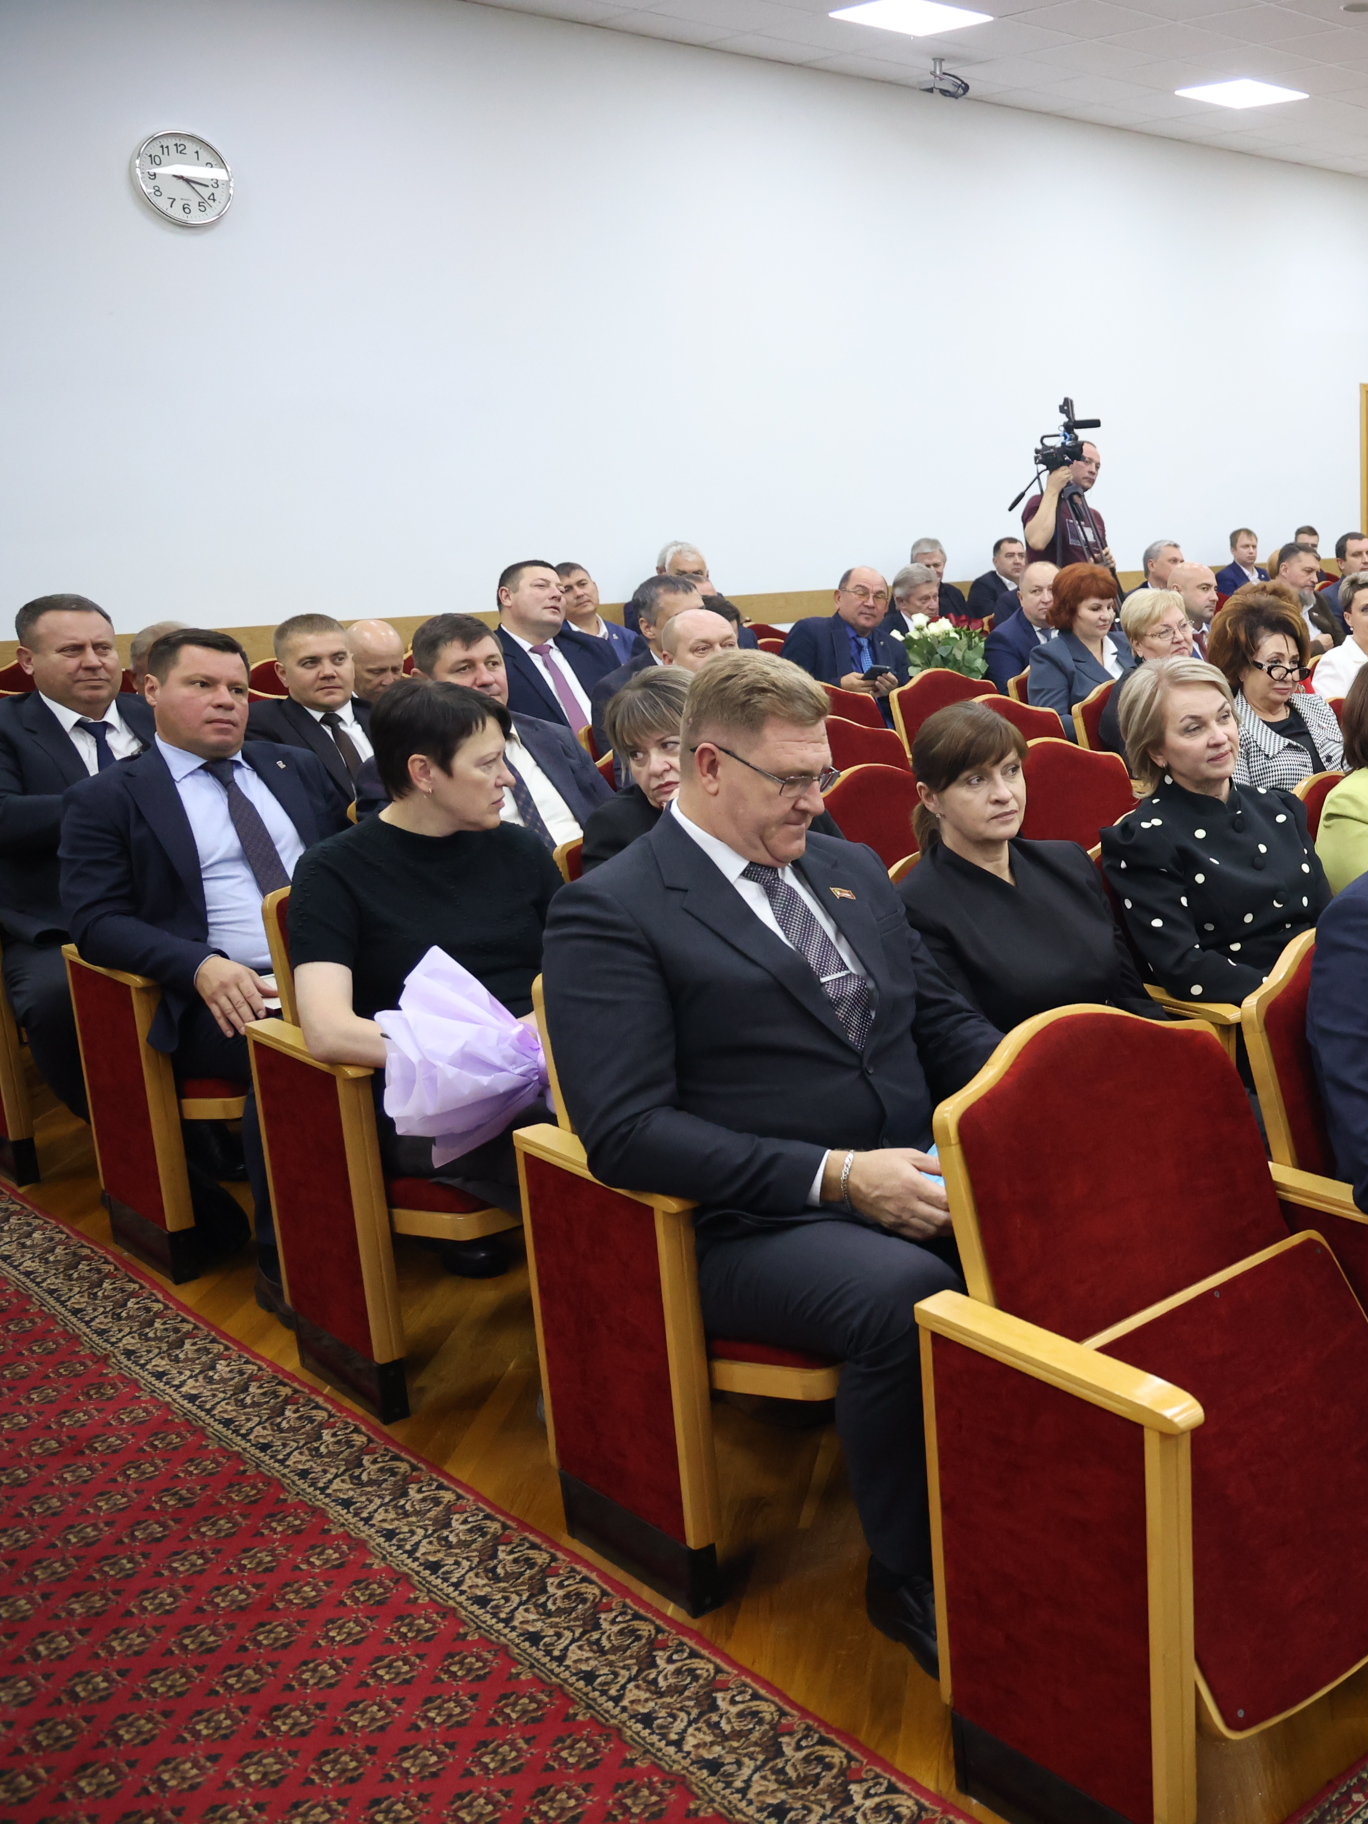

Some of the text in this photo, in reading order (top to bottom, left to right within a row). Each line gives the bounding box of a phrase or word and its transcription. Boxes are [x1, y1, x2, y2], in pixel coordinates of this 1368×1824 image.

[160, 144, 170, 156] 11
[174, 143, 187, 155] 12
[148, 154, 162, 166] 10
[194, 150, 200, 161] 1
[147, 170, 157, 180] 9
[210, 178, 219, 189] 3
[152, 185, 162, 197] 8
[167, 197, 176, 208] 7
[207, 192, 216, 203] 4
[182, 203, 192, 215] 6
[198, 201, 207, 213] 5
